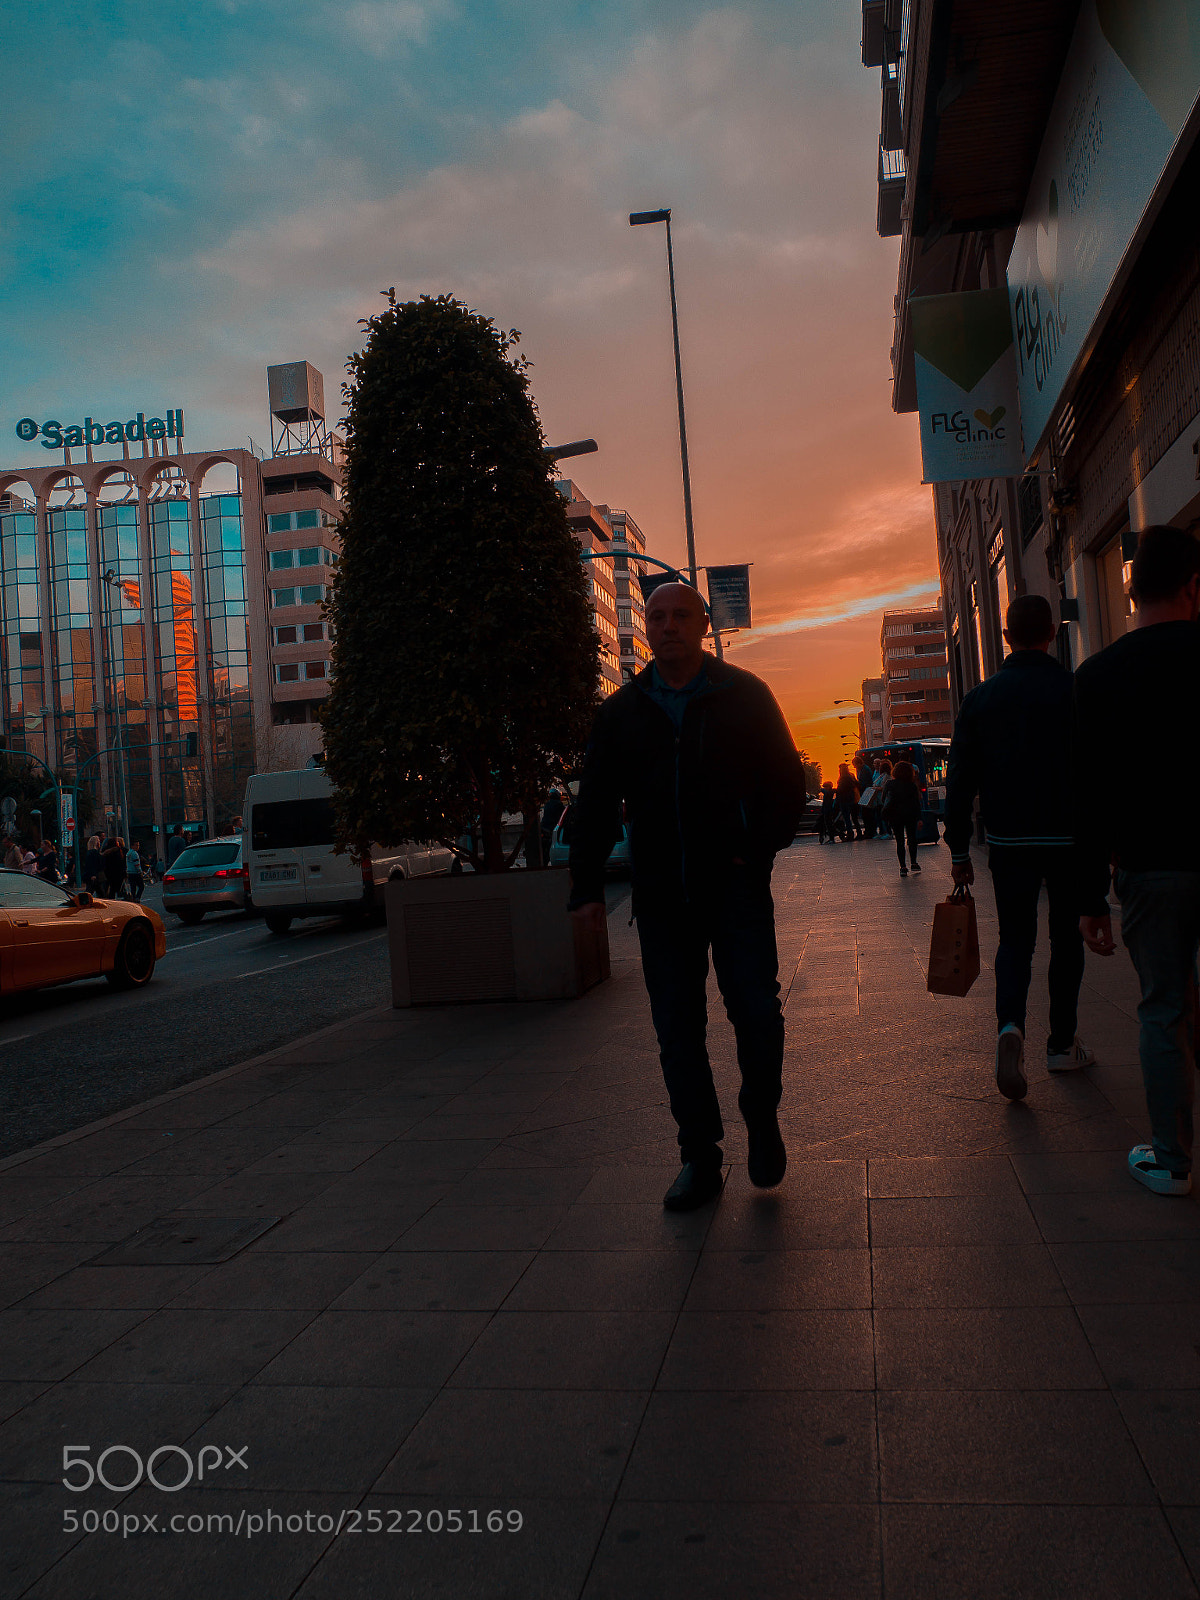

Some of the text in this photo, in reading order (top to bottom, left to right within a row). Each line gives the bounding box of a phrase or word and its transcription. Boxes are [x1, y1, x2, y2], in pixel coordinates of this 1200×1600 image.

[1015, 286, 1041, 376] FLG
[1034, 284, 1067, 392] clinic
[41, 408, 184, 449] Sabadell
[931, 411, 970, 434] FLG
[955, 425, 1006, 443] clinic
